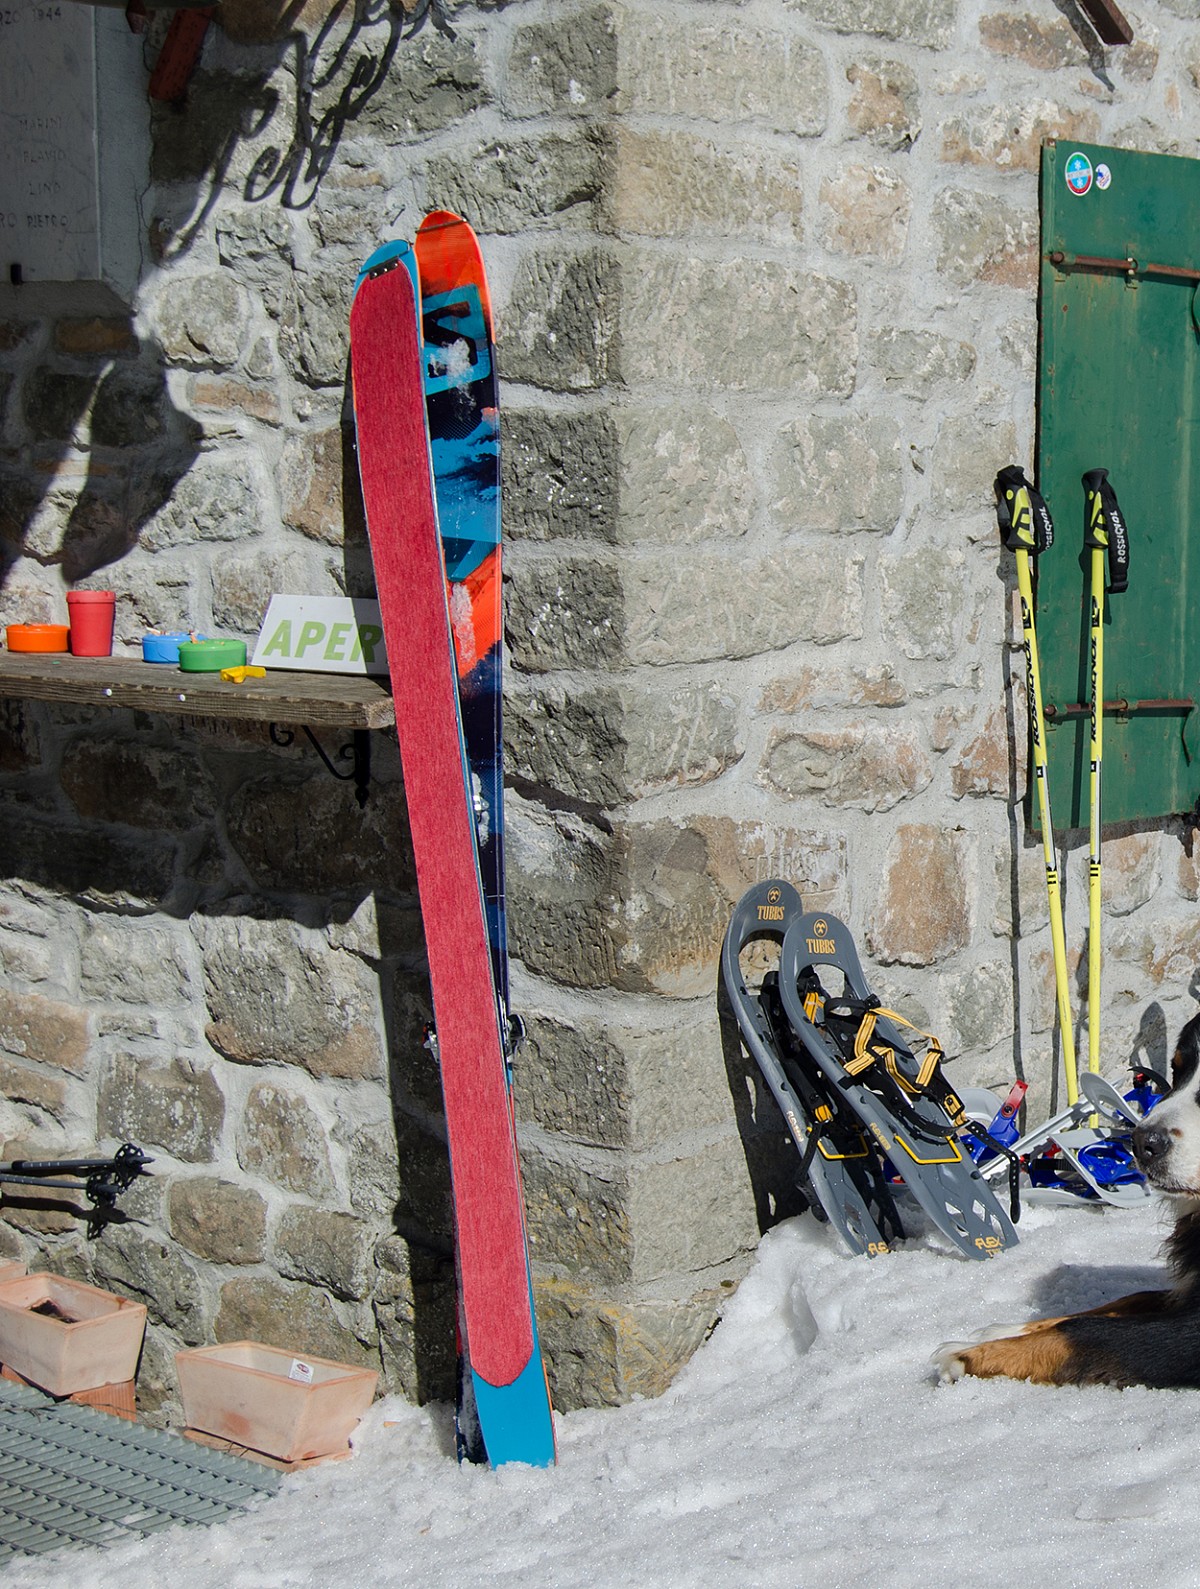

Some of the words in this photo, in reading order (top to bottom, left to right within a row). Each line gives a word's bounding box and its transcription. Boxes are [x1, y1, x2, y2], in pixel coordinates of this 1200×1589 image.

[32, 6, 62, 22] 1944
[26, 214, 69, 229] PIETRO
[1109, 510, 1126, 563] ROSSIGNOL
[262, 619, 389, 663] APER
[1024, 636, 1041, 747] ROSSIGNOL
[1090, 636, 1098, 743] ROSSIGNOL
[757, 905, 785, 921] TUBBS
[805, 938, 836, 954] TUBBS
